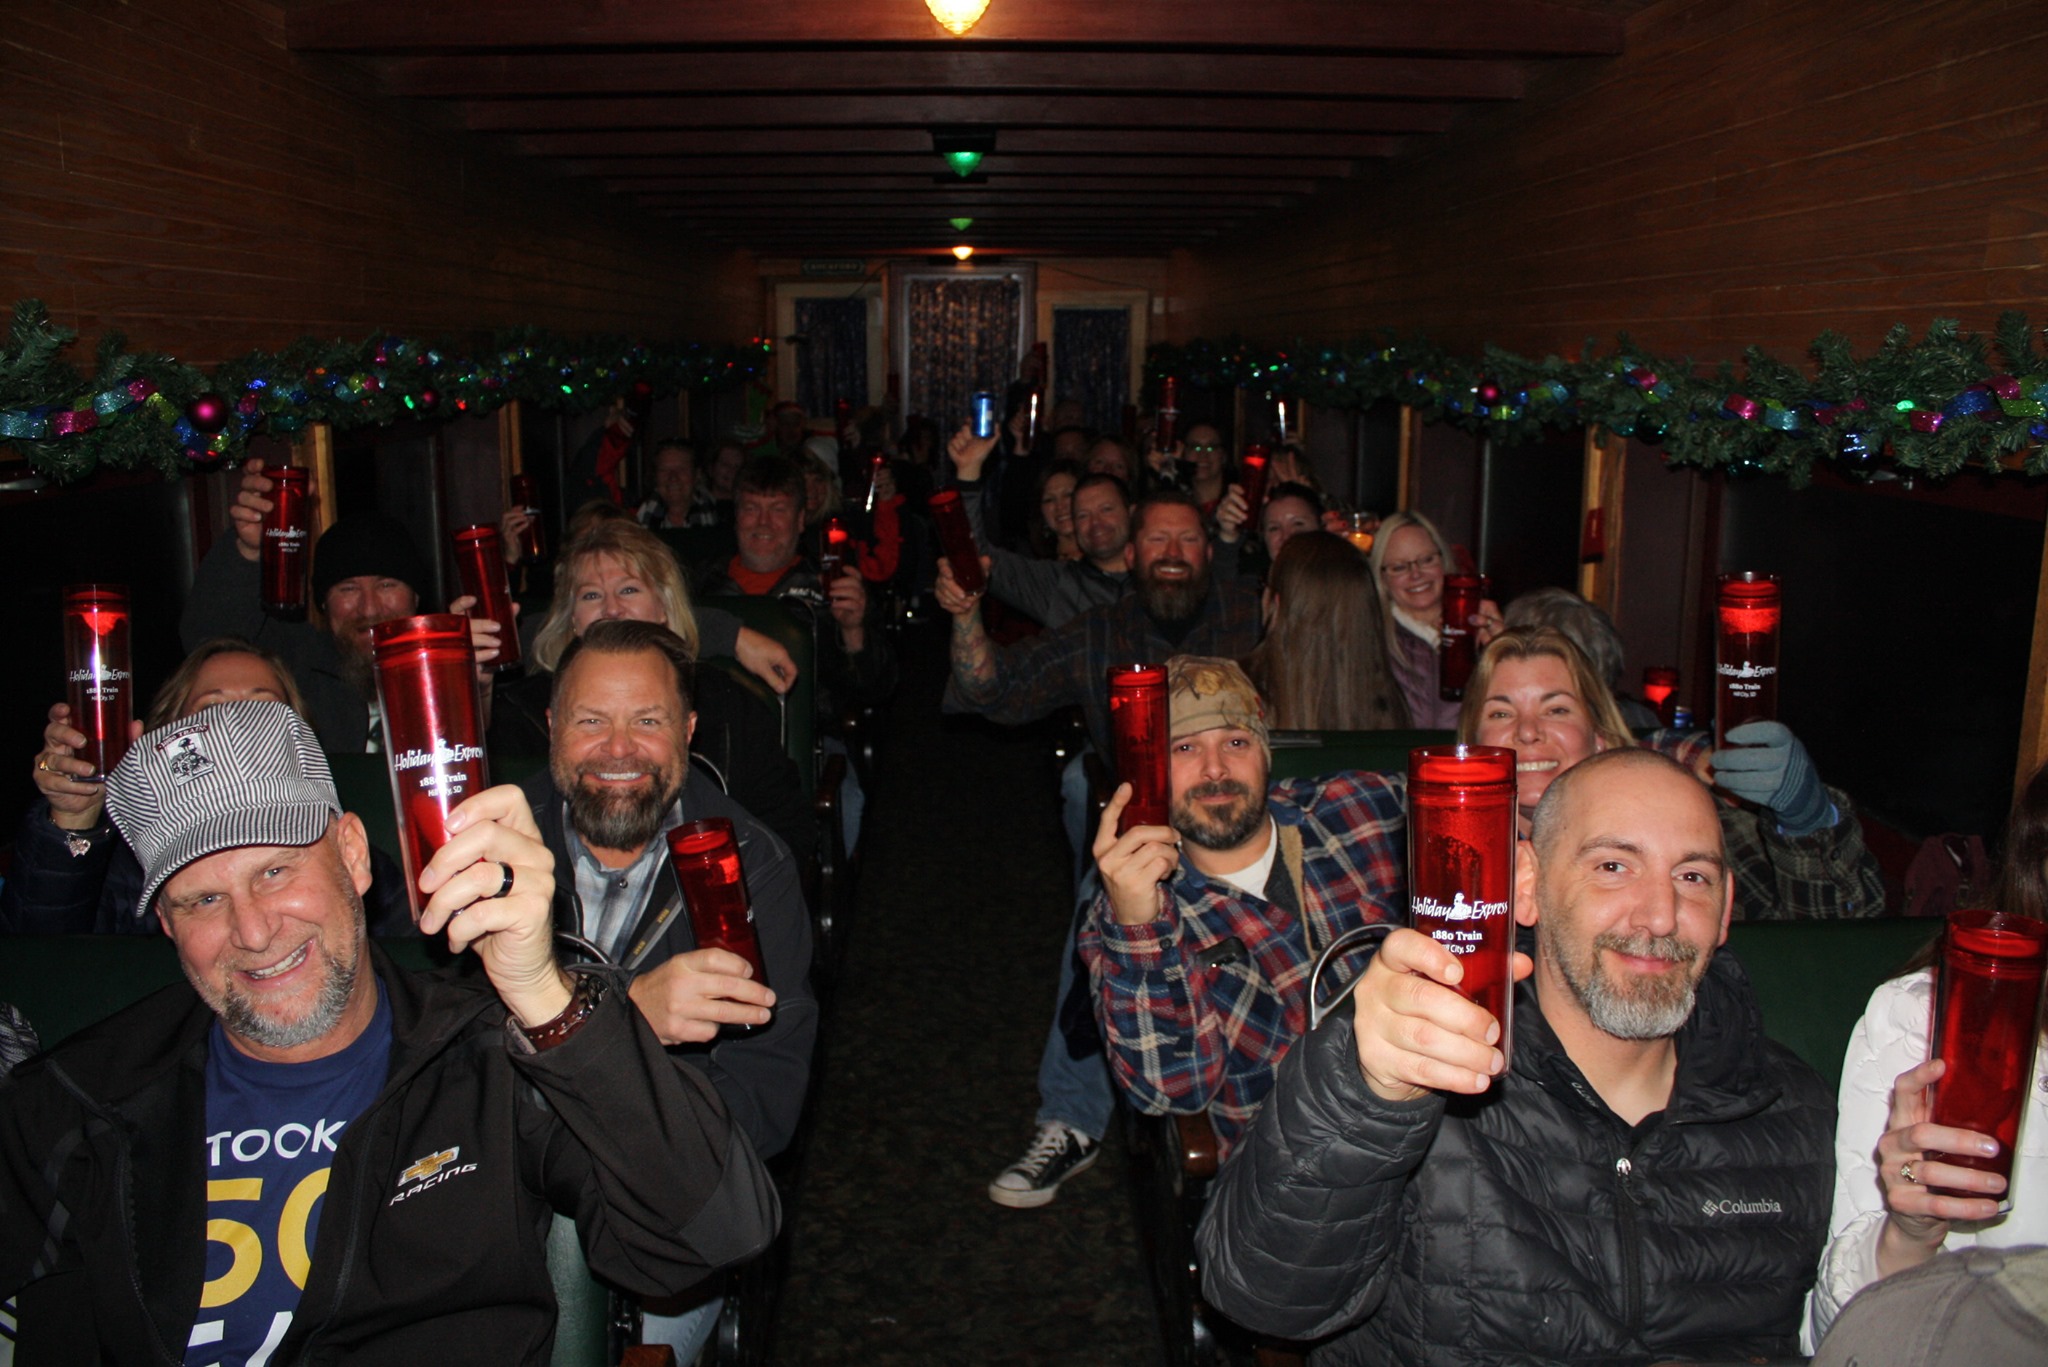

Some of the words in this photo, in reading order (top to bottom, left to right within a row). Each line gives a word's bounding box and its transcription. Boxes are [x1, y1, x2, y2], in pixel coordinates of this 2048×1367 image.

[69, 669, 98, 682] Holida
[395, 749, 437, 771] Holiday
[419, 776, 438, 788] 188
[453, 785, 462, 794] SD
[1412, 896, 1452, 922] Holiday
[1471, 901, 1508, 920] Express
[1432, 930, 1454, 941] 1880
[1456, 930, 1482, 941] Train
[1465, 944, 1475, 953] SD
[206, 1118, 347, 1166] TOOK
[389, 1163, 478, 1206] RACING
[1719, 1199, 1782, 1214] Columbia
